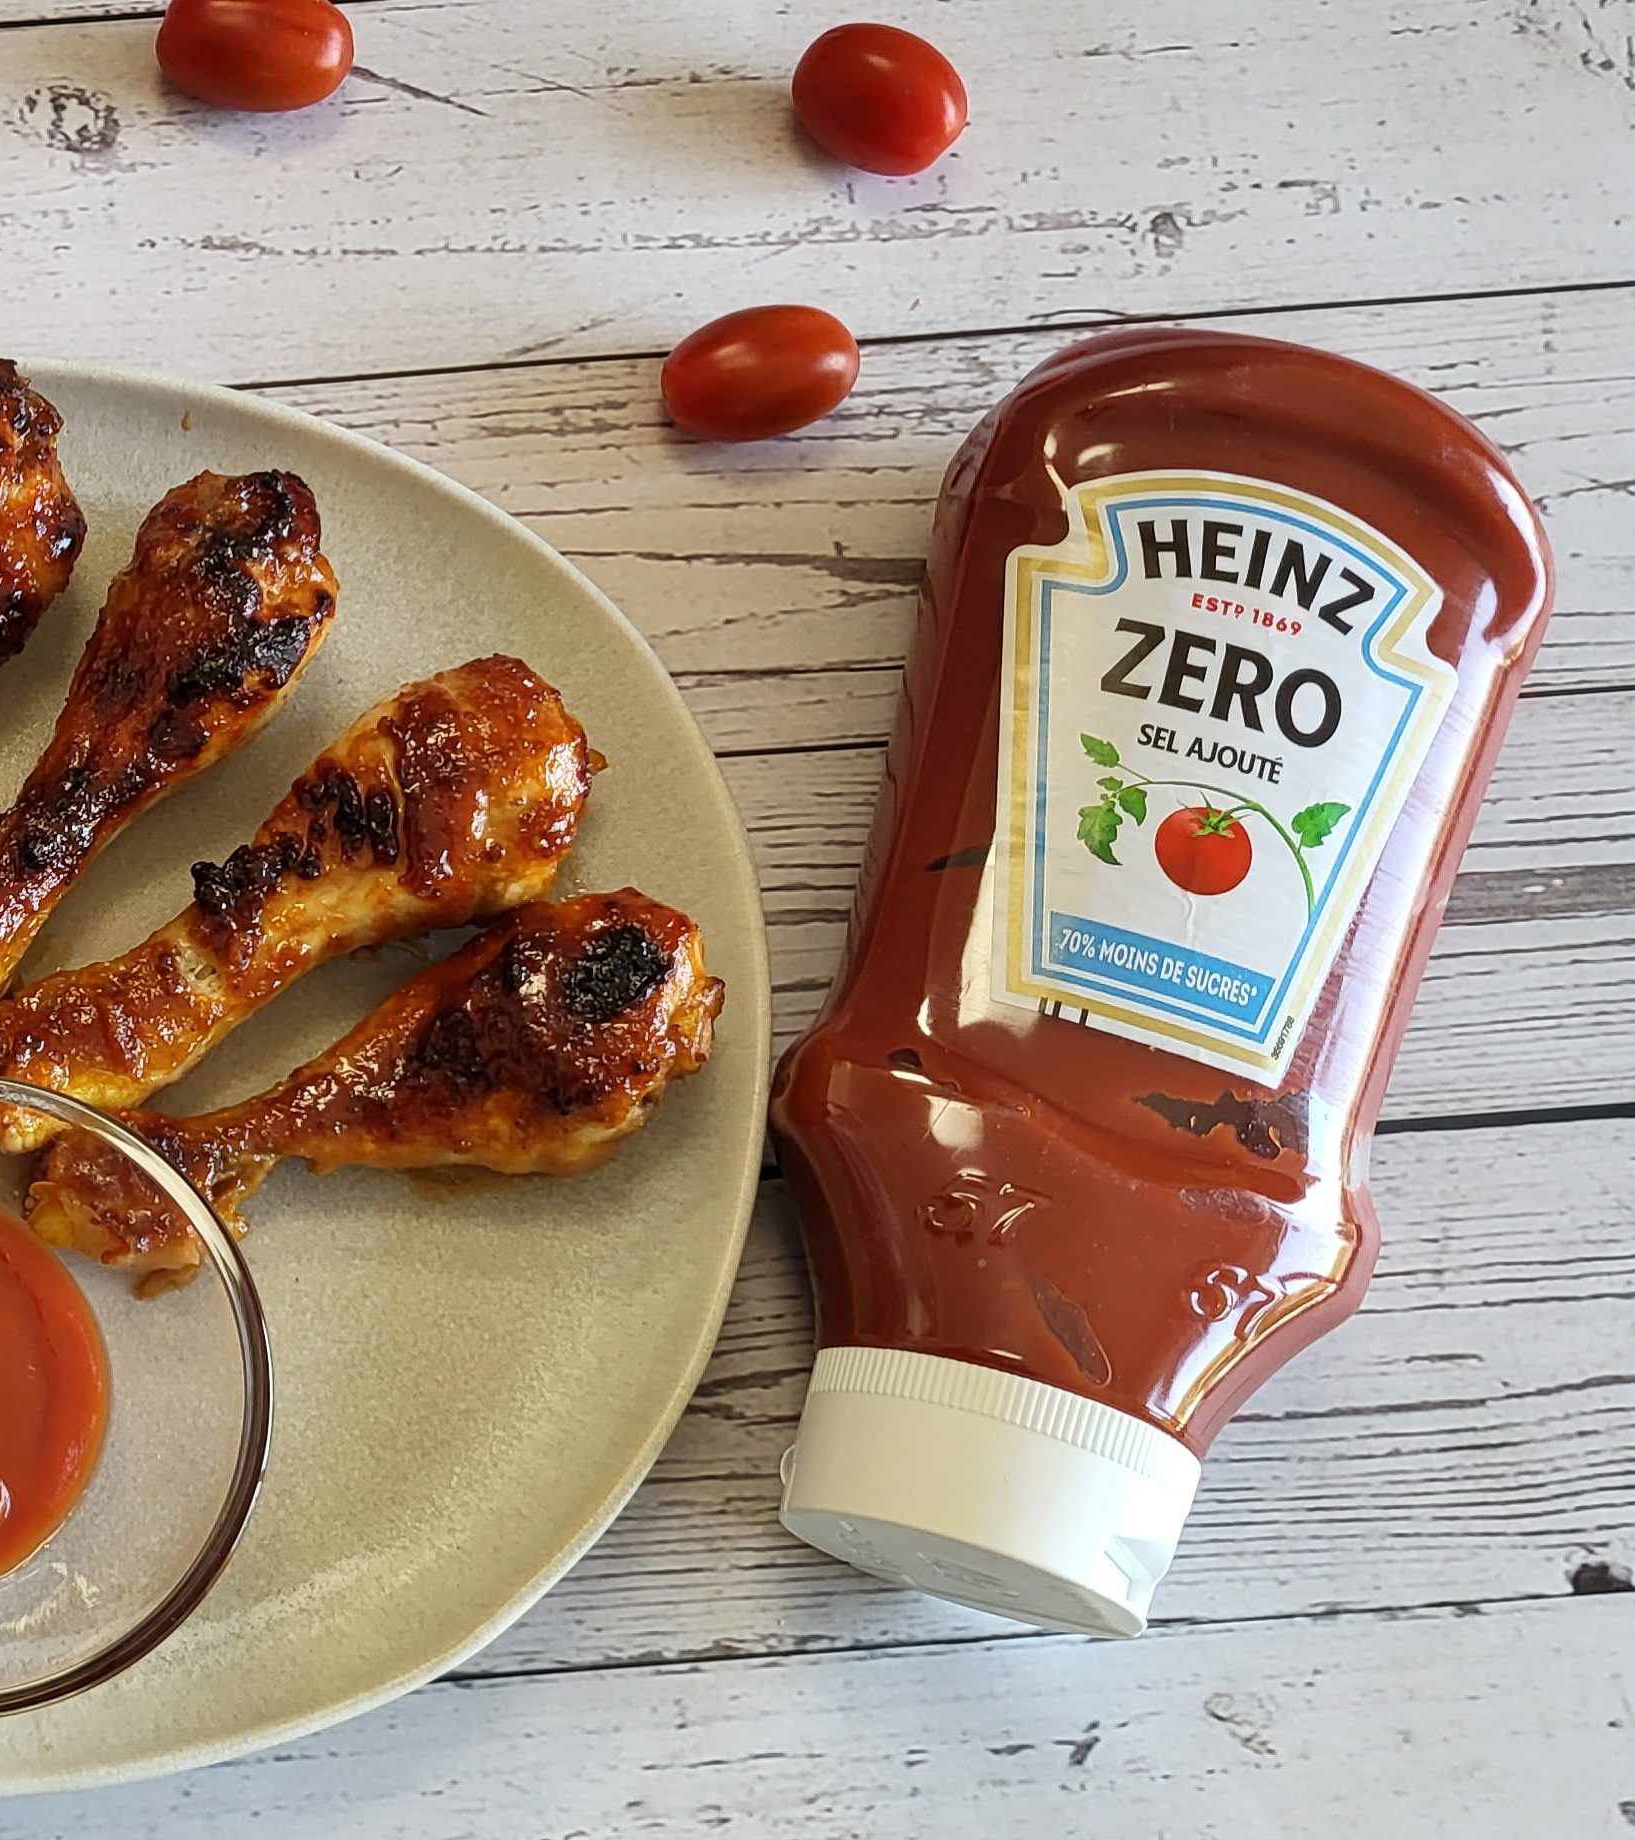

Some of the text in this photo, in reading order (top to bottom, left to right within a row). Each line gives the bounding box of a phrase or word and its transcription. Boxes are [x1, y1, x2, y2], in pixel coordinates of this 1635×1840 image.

[1137, 519, 1375, 636] HEINZ
[1252, 607, 1302, 636] 1869
[1101, 617, 1342, 748] ZERO
[1137, 723, 1283, 784] SEL AJOUTÉ
[1060, 928, 1096, 958] 70%
[1098, 938, 1159, 976] MOINS
[1160, 957, 1183, 984] DE
